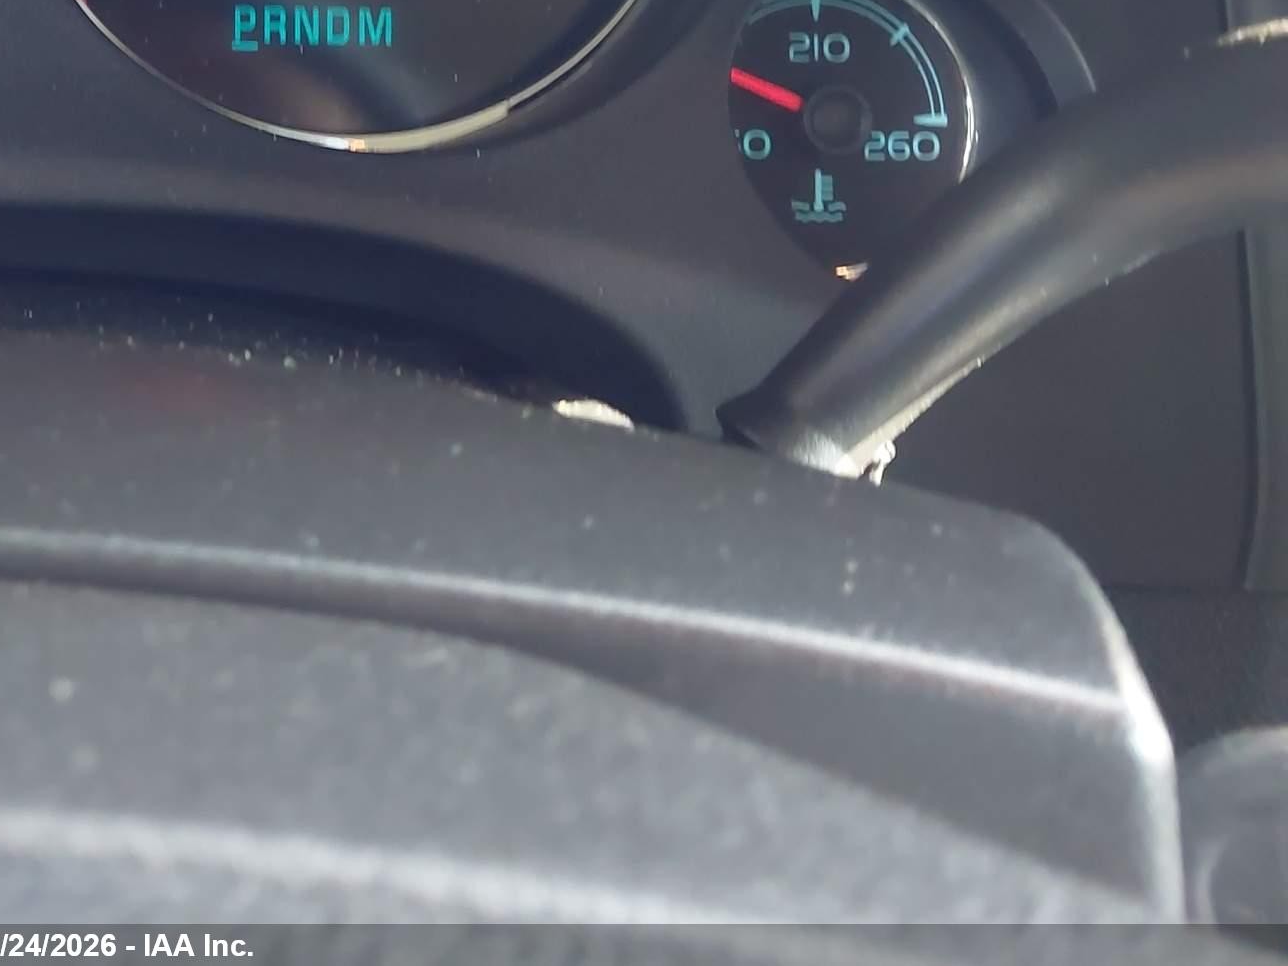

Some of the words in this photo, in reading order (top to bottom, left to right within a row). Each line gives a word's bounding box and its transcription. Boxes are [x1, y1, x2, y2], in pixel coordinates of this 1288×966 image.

[234, 4, 392, 47] PRNDM
[788, 33, 850, 63] 210
[864, 132, 941, 162] 260
